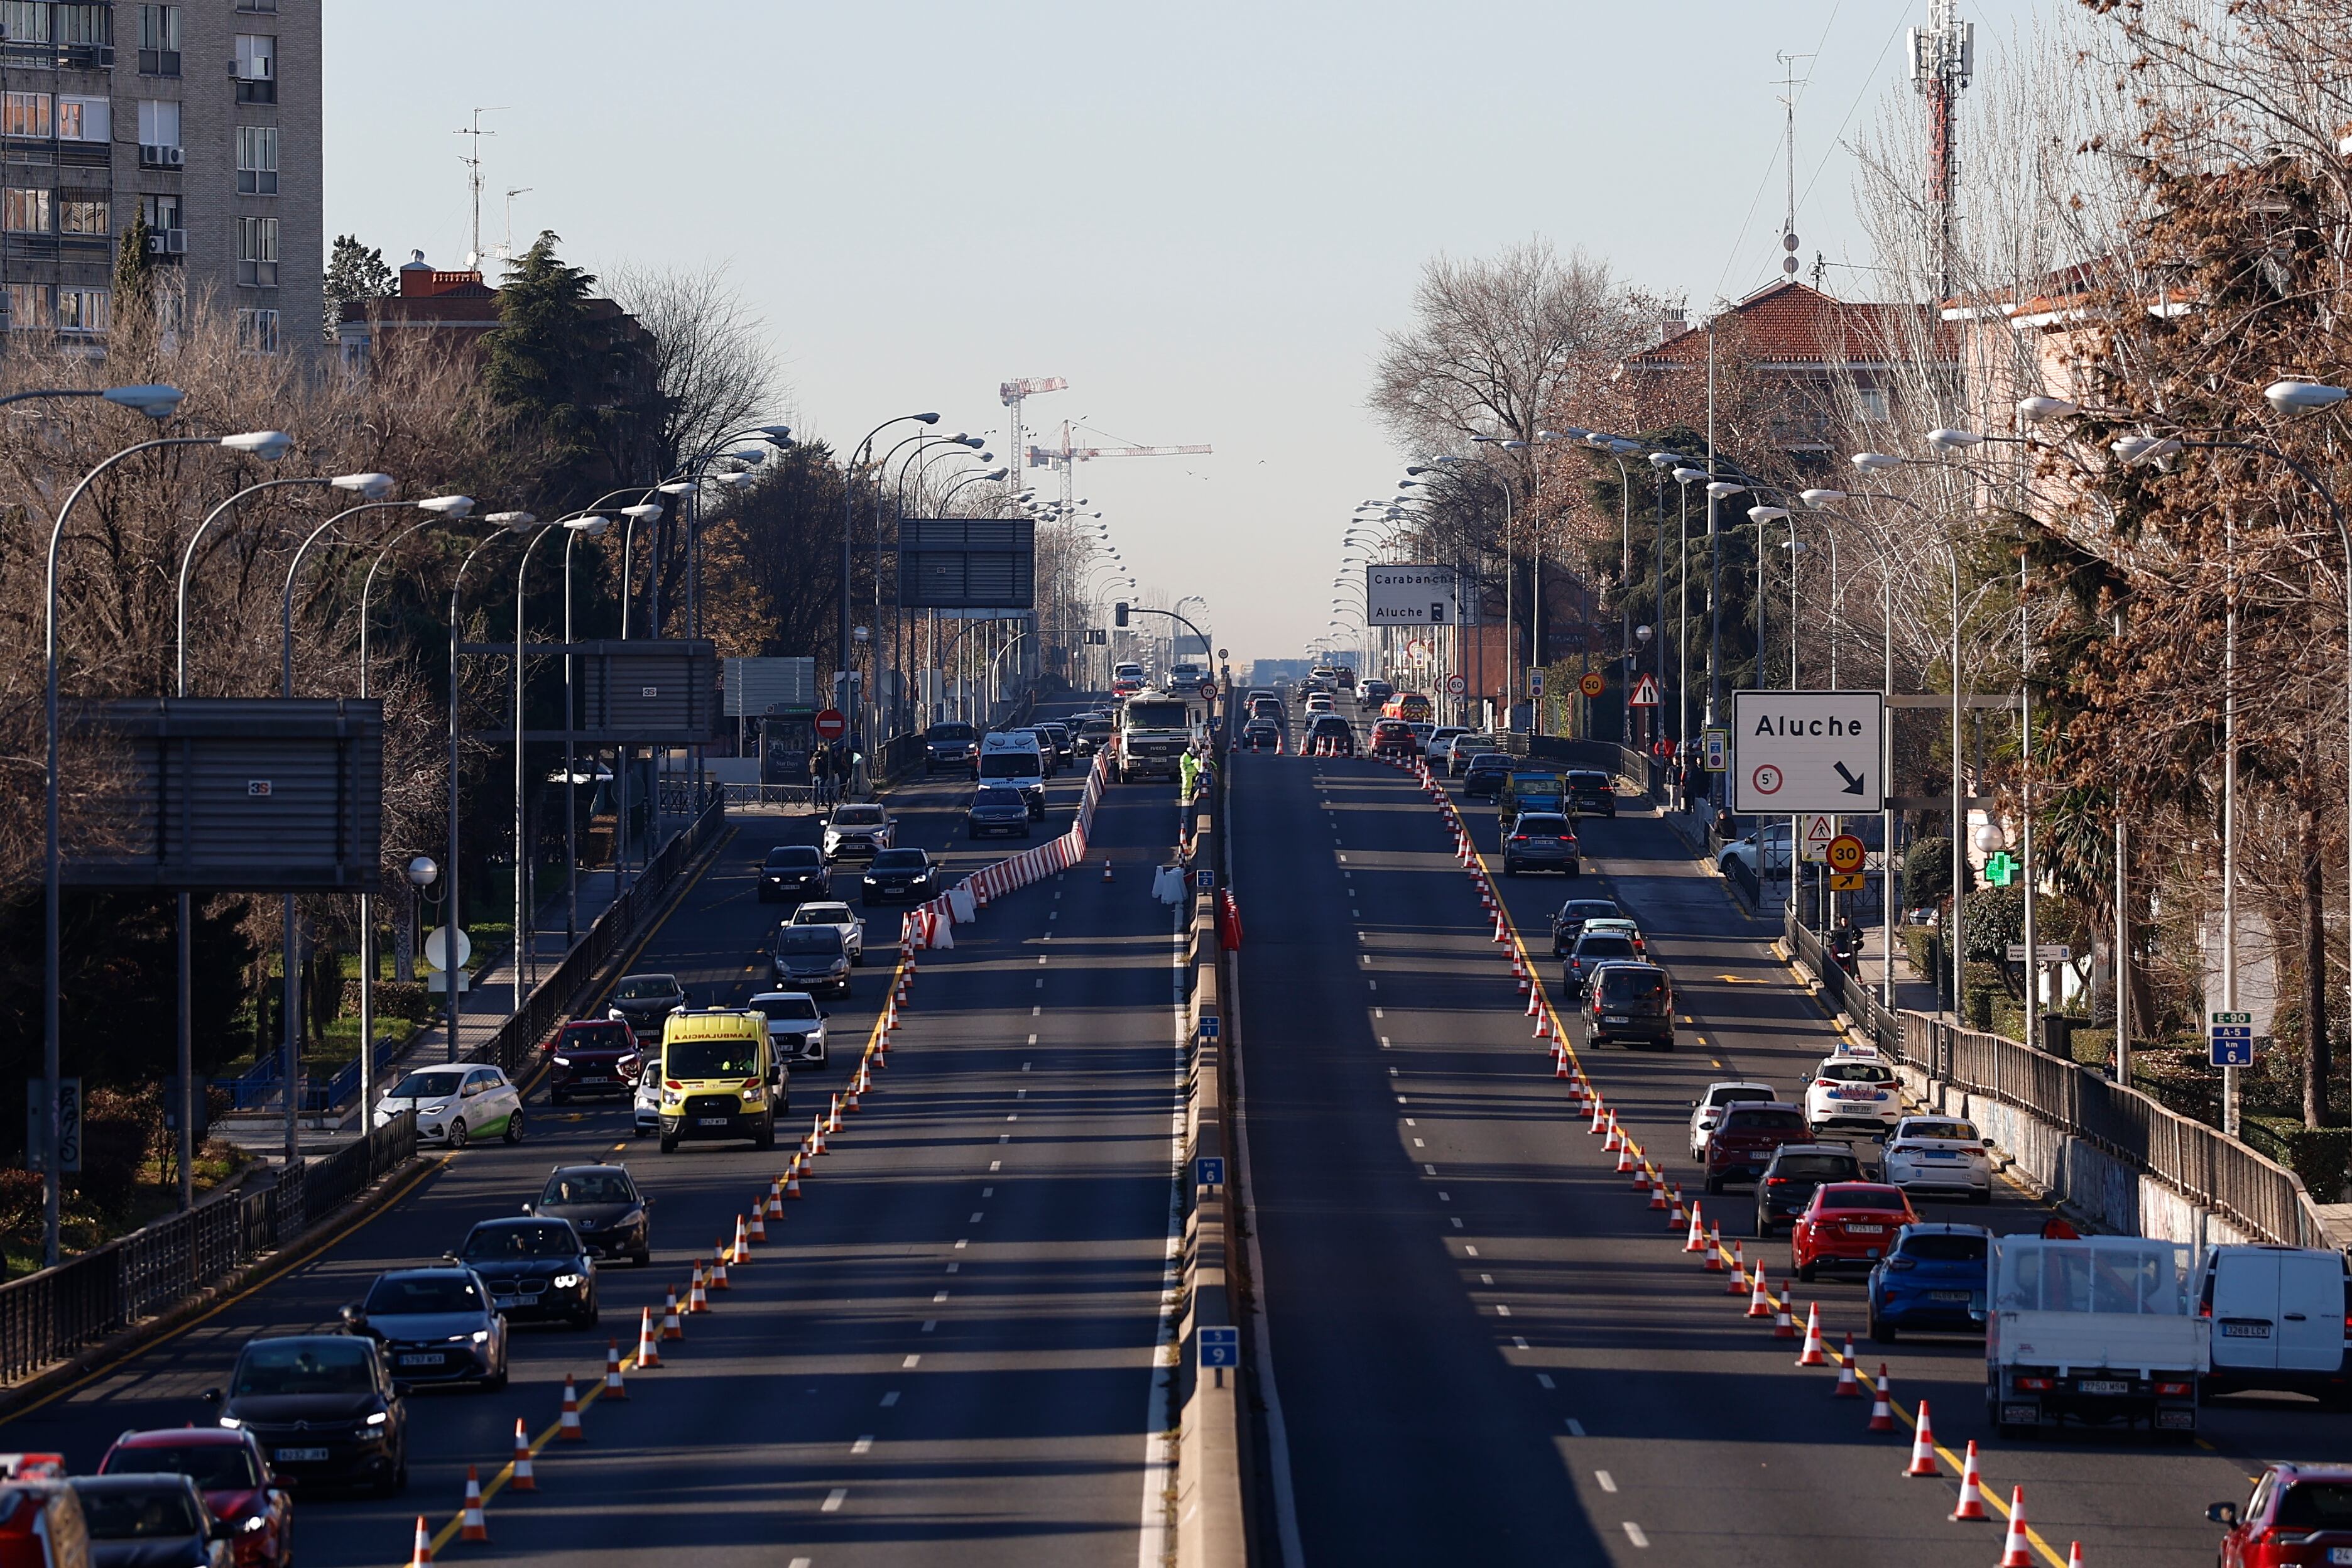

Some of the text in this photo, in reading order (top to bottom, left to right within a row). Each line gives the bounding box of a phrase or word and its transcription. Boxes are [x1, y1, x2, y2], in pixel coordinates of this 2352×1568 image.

[1375, 575, 1459, 584] Carabanche
[1376, 607, 1422, 617] Aluche
[1585, 680, 1599, 689] 50
[1755, 715, 1862, 736] Aluche
[251, 782, 269, 794] 3S
[1835, 847, 1856, 861] 30
[2217, 1013, 2246, 1023] E-90
[1207, 1026, 1211, 1035] 1
[2223, 1028, 2241, 1036] A-5
[2227, 1050, 2236, 1063] 6
[1206, 1170, 1214, 1182] 6
[1849, 1224, 1868, 1233] 3725
[1214, 1331, 1222, 1341] 5
[2251, 1327, 2267, 1335] LCK
[1212, 1348, 1225, 1363] 9
[2084, 1381, 2126, 1391] 2750 MSM
